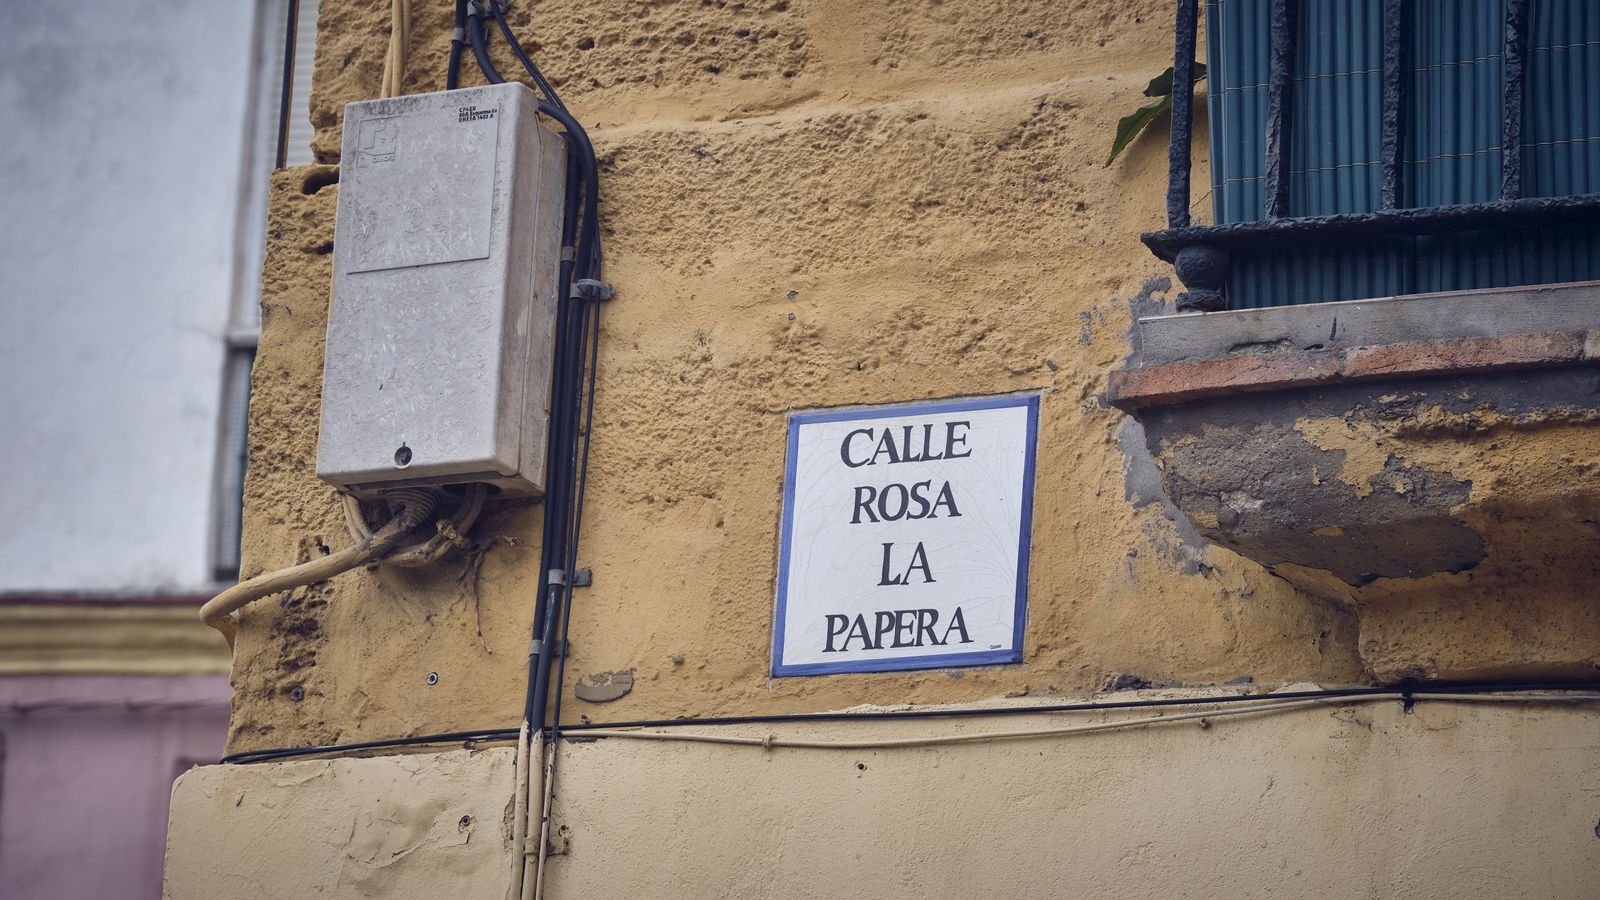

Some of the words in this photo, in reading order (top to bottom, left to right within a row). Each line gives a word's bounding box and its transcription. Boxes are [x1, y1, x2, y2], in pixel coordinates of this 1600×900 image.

[840, 421, 973, 469] CALLE
[849, 479, 962, 524] ROSA
[877, 541, 936, 586] LA
[822, 606, 974, 653] PAPERA
